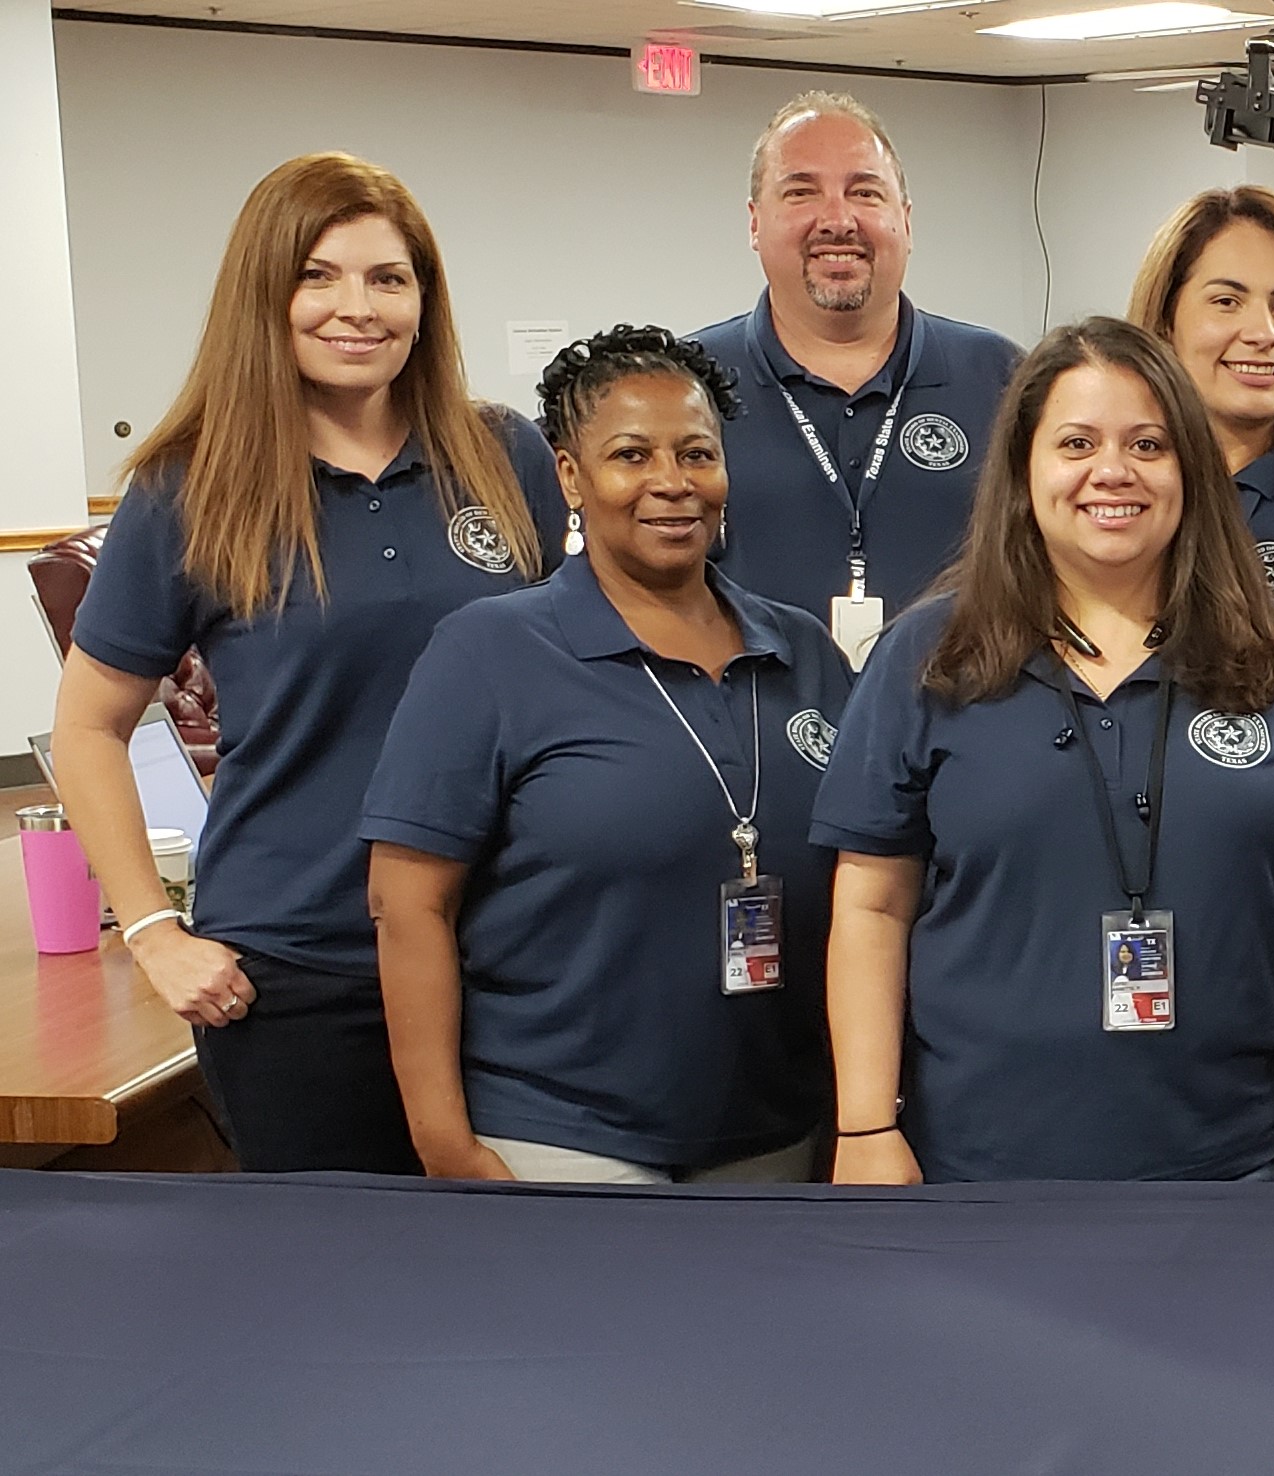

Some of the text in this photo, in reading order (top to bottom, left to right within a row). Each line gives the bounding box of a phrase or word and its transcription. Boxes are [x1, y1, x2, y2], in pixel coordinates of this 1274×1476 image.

[646, 45, 692, 91] EXIT
[801, 423, 838, 483] Examiners
[865, 418, 894, 480] Texas State
[730, 967, 743, 977] 22
[1114, 1003, 1129, 1013] 22
[1153, 1001, 1167, 1012] E1
